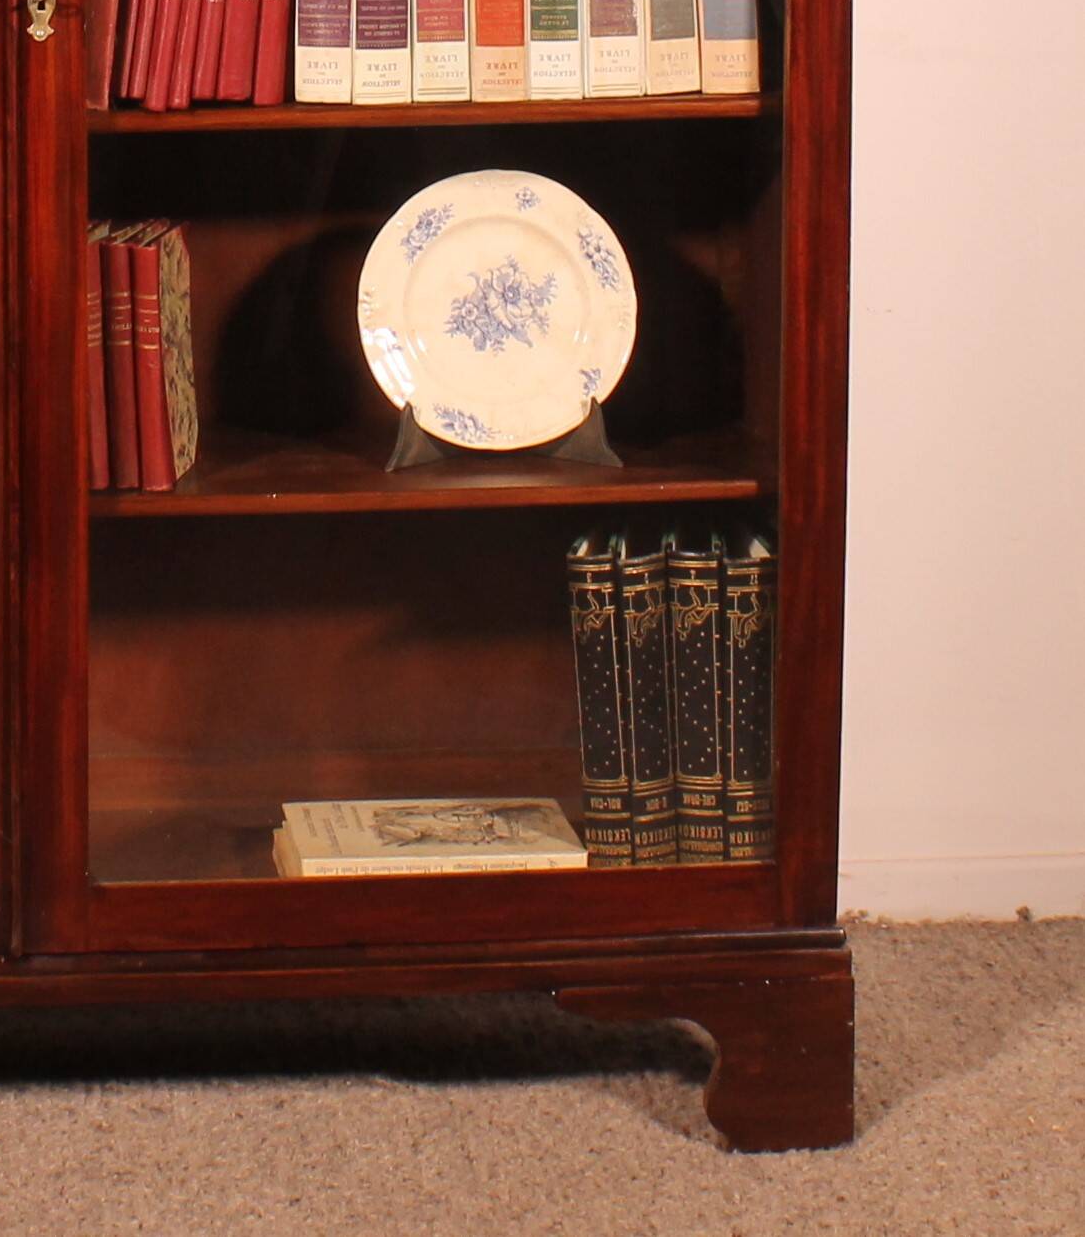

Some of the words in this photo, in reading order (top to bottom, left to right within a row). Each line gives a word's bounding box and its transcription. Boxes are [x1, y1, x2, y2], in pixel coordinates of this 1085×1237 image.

[424, 54, 459, 63] LIVRE
[538, 54, 571, 63] LIVRE
[599, 49, 631, 59] LIVRE
[306, 61, 339, 70] LIVRE
[366, 63, 398, 73] LIVRE
[485, 62, 519, 72] LIVRE
[584, 826, 631, 843] LEKSIKON
